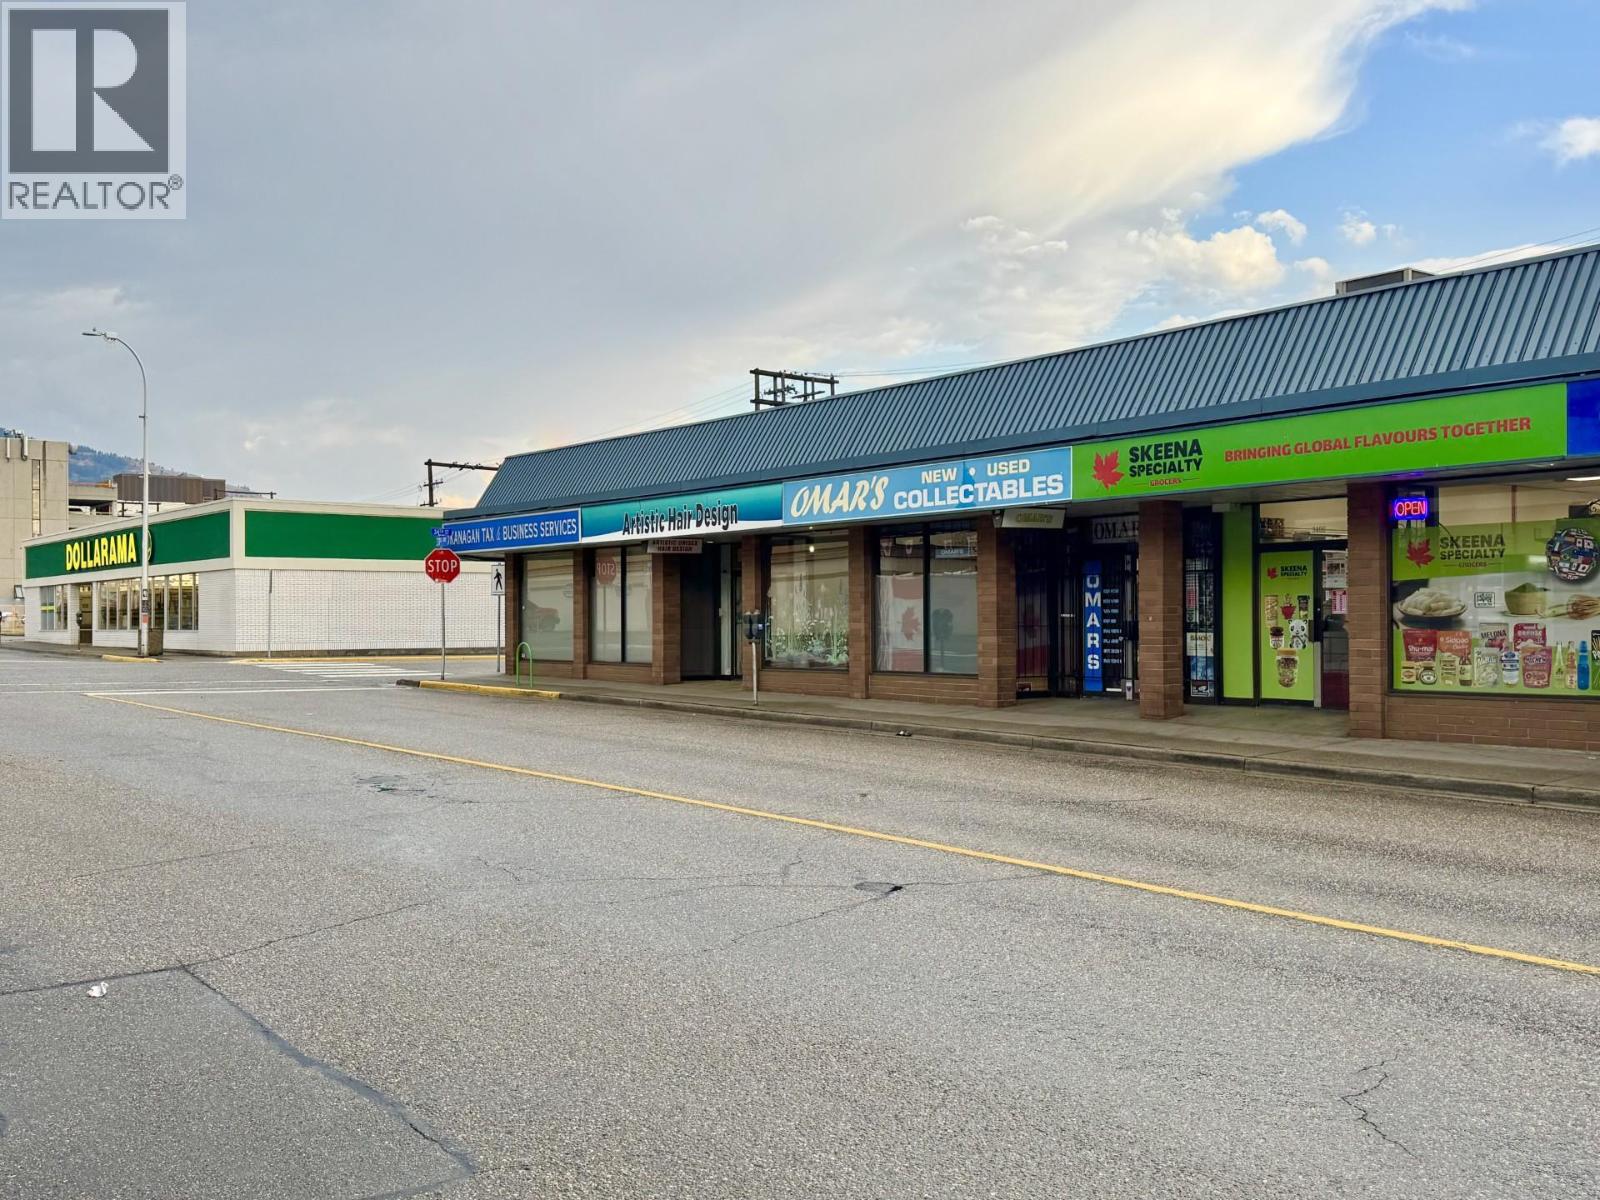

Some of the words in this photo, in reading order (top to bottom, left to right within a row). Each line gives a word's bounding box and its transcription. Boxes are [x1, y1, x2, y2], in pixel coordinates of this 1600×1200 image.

[1128, 438, 1203, 463] SKEENA
[1224, 442, 1291, 463] BRINGING
[1294, 437, 1352, 455] GLOBAL
[1354, 427, 1438, 449] FLAVOURS
[1440, 416, 1532, 439] TOGETHER
[921, 468, 957, 485] NEW
[987, 459, 1030, 477] USED
[1128, 457, 1204, 478] SPECIALTY
[893, 474, 1064, 510] COLLECTABLES
[1150, 477, 1183, 487] GROCERS
[790, 475, 889, 518] OMAR'S
[1396, 502, 1426, 516] OPEN
[622, 508, 665, 536] Artistic
[668, 504, 694, 531] Hair
[696, 499, 739, 531] Design
[447, 528, 481, 546] KANAGAN
[481, 527, 495, 543] TAX
[503, 523, 539, 541] BUSINESS
[541, 518, 578, 537] SERVICES
[1440, 533, 1506, 549] SKEENA
[65, 532, 137, 571] DOLLARAMA
[1440, 548, 1506, 560] SPECIALTY
[428, 559, 457, 573] STOP
[1085, 575, 1101, 670] OMARS
